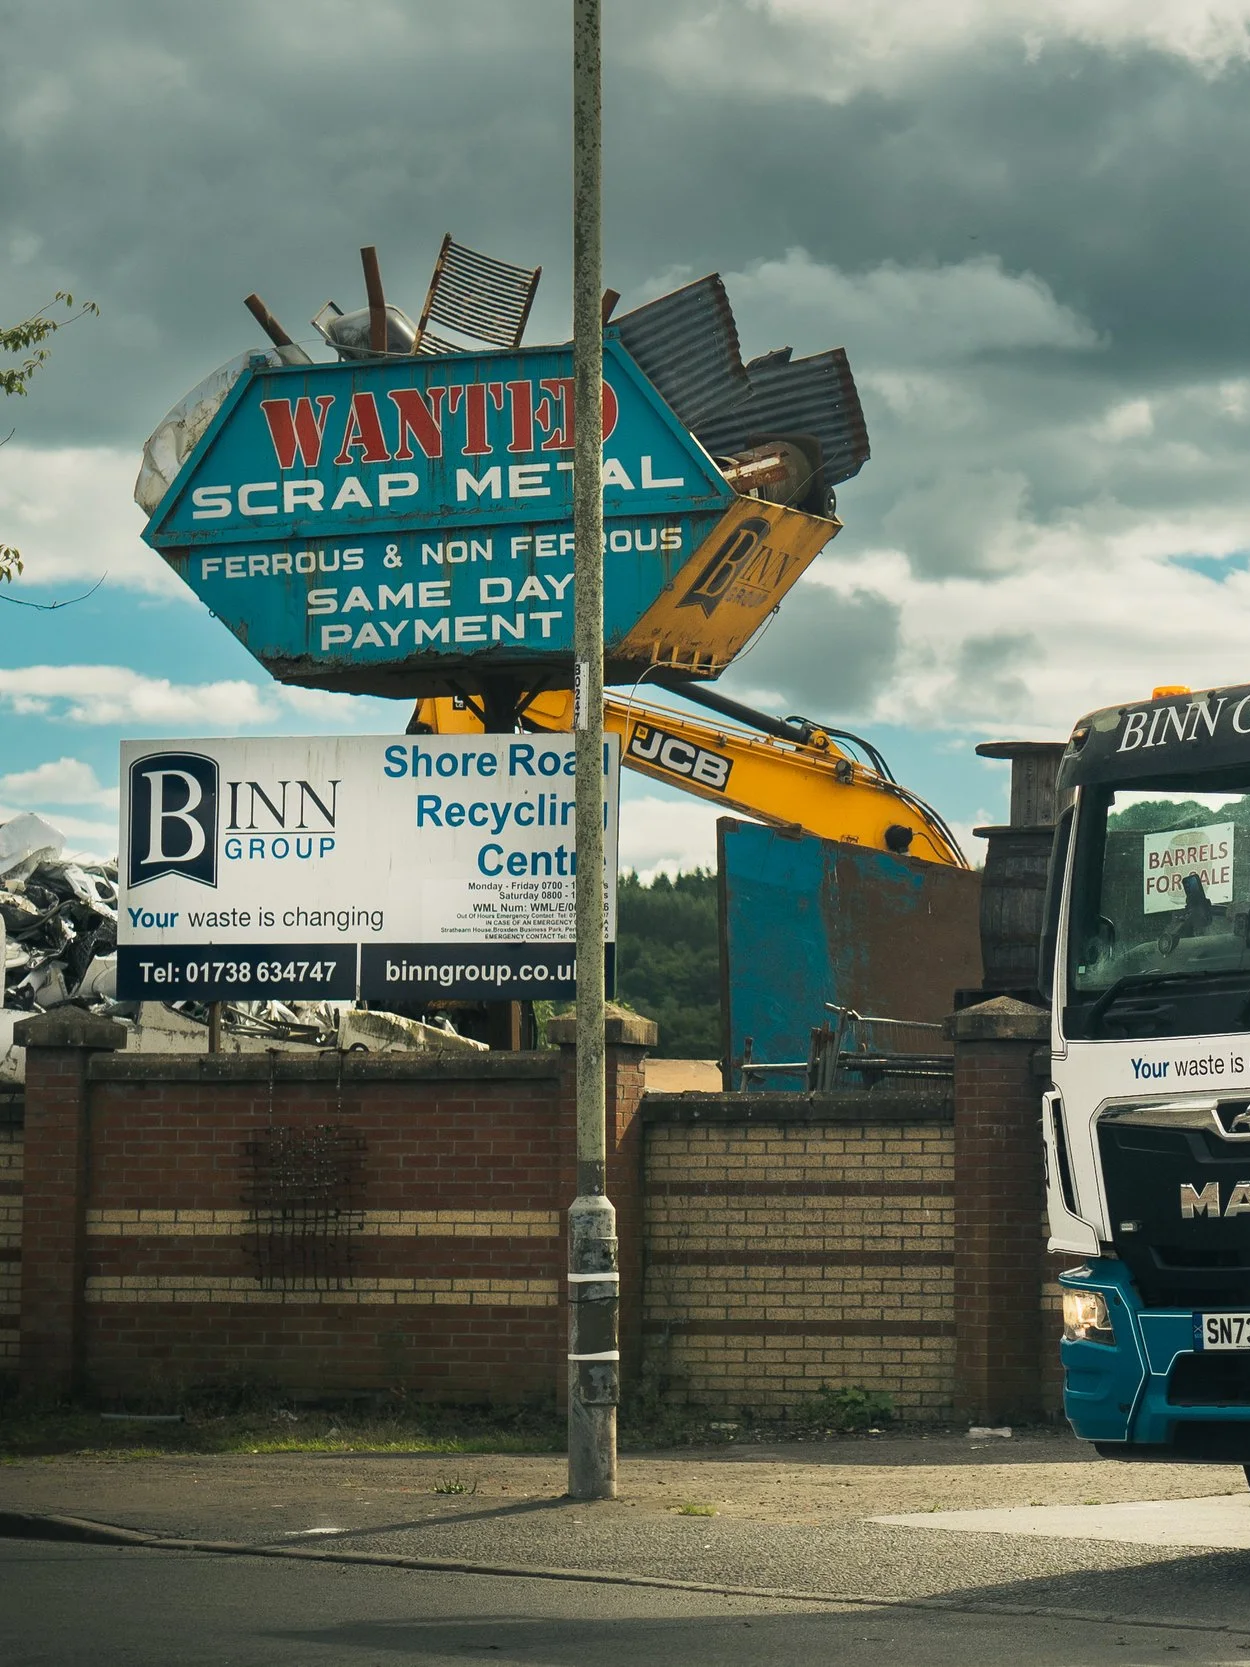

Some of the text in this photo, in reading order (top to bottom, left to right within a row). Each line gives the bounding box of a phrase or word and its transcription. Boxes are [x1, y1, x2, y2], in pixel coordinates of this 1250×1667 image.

[192, 472, 419, 520] SCRAP
[201, 527, 683, 580] FERROUS & NON FEROUS
[307, 573, 575, 615] SAME DAY
[321, 611, 562, 651] PAYMENT
[1116, 697, 1229, 753] BINN
[383, 743, 609, 778] Shore Roa
[631, 731, 729, 787] JCB
[417, 793, 608, 836] Recyclin
[225, 837, 335, 860] GROUP
[477, 844, 606, 877] Cent
[1149, 841, 1229, 869] BARRELS
[468, 882, 503, 892] Monday
[511, 881, 539, 891] Friday
[541, 881, 563, 890] 0700
[499, 891, 539, 901] Saturday
[541, 891, 563, 899] 0800
[1146, 866, 1230, 895] FOR ALE
[127, 906, 384, 931] Your waste is changing
[473, 903, 498, 912] WML
[500, 903, 527, 912] Num:
[139, 961, 337, 983] Tel: 01738 634747
[1130, 1058, 1169, 1080] Your
[1175, 1054, 1225, 1076] waste
[1230, 1051, 1245, 1073] is
